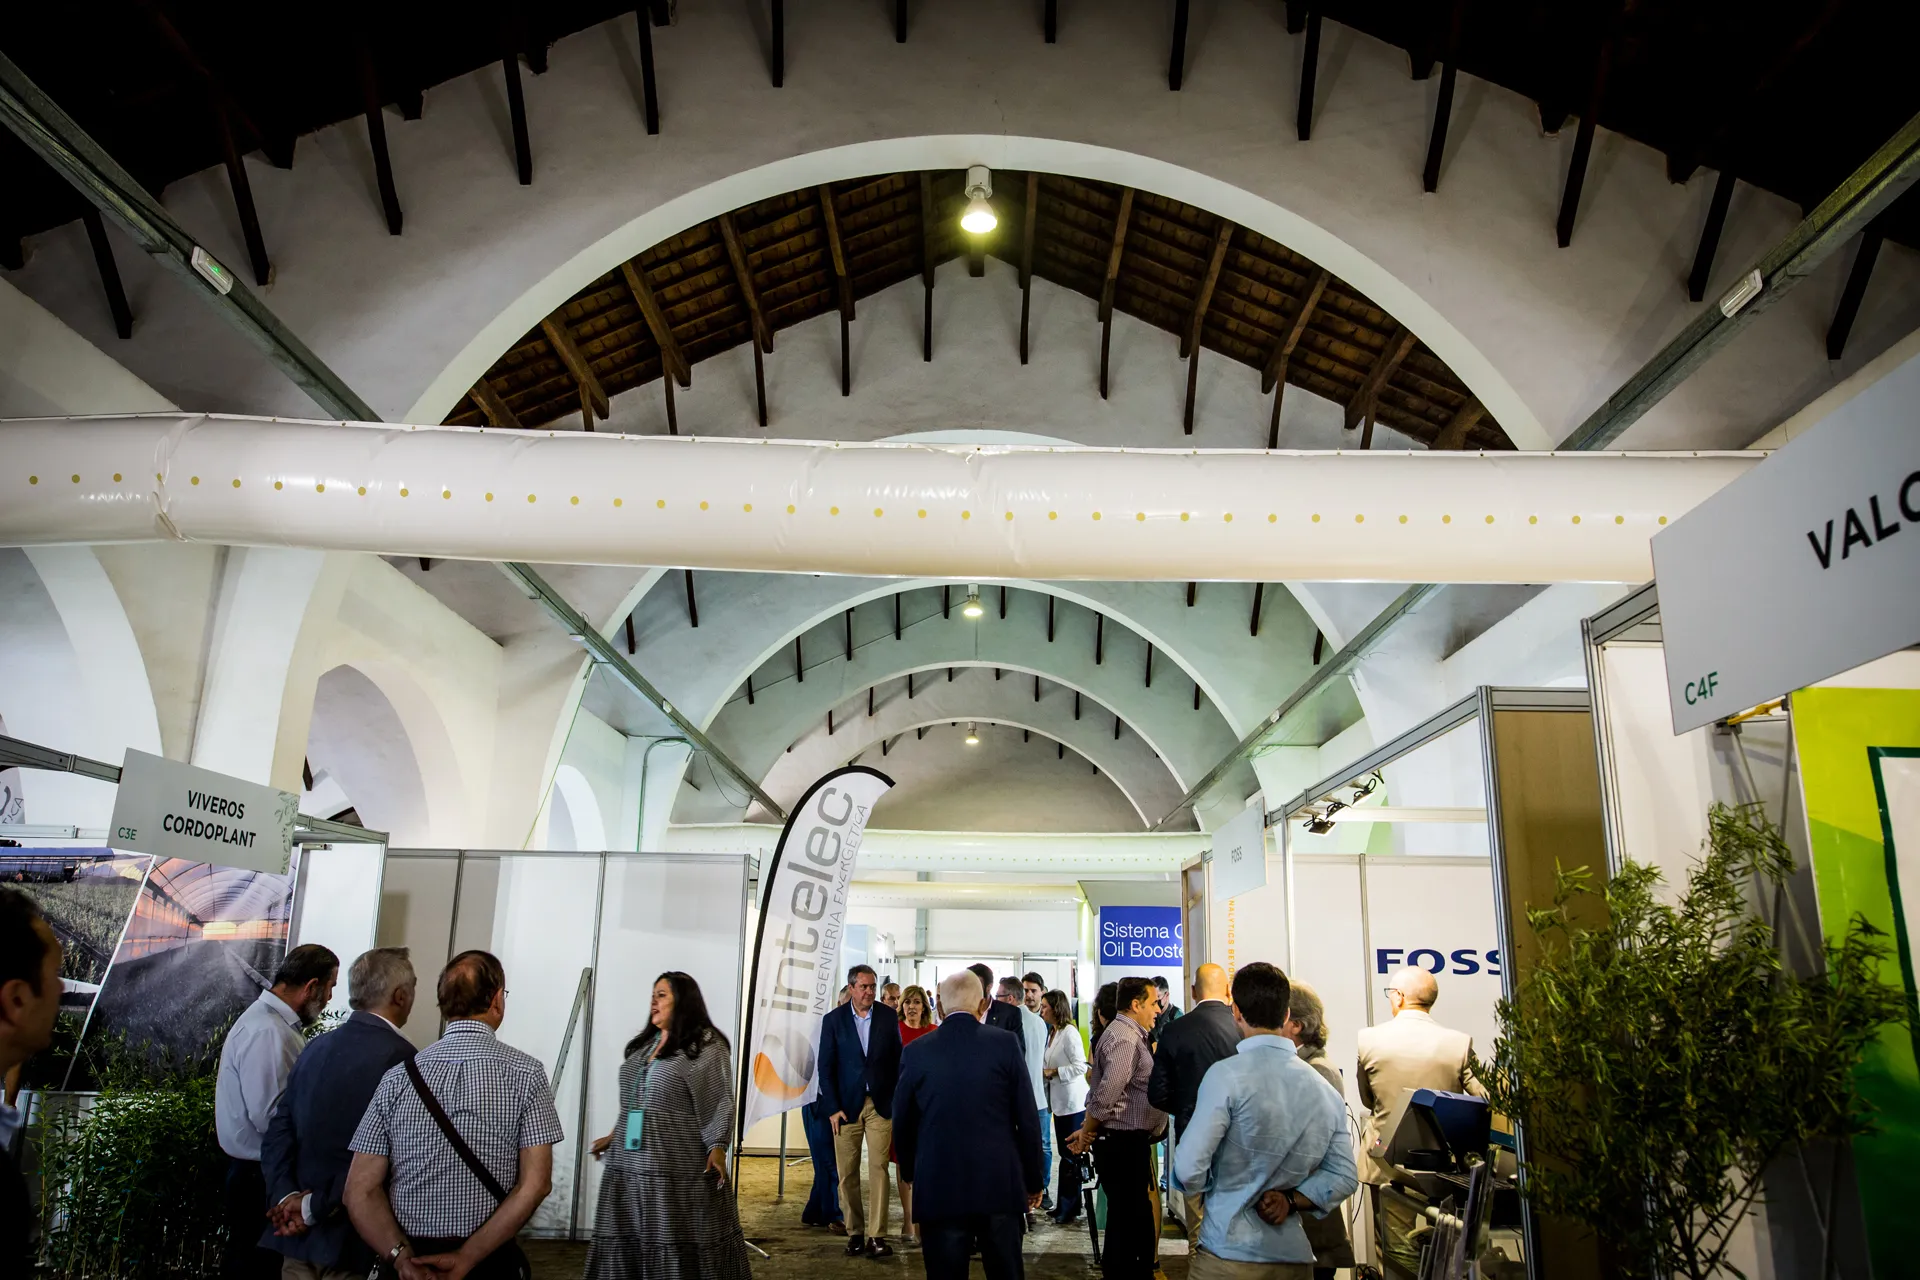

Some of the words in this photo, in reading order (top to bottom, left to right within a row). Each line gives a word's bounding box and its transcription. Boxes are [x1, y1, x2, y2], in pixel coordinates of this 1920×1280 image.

[1685, 671, 1718, 705] C4F
[188, 790, 245, 820] VIVEROS
[118, 827, 137, 840] C3E
[163, 814, 256, 848] CORDOPLANT
[761, 787, 853, 1013] intelec
[1103, 922, 1169, 939] Sistema
[1227, 896, 1235, 945] NALYTICS
[812, 911, 842, 1016] INGENIERIA
[1103, 941, 1124, 957] Oil
